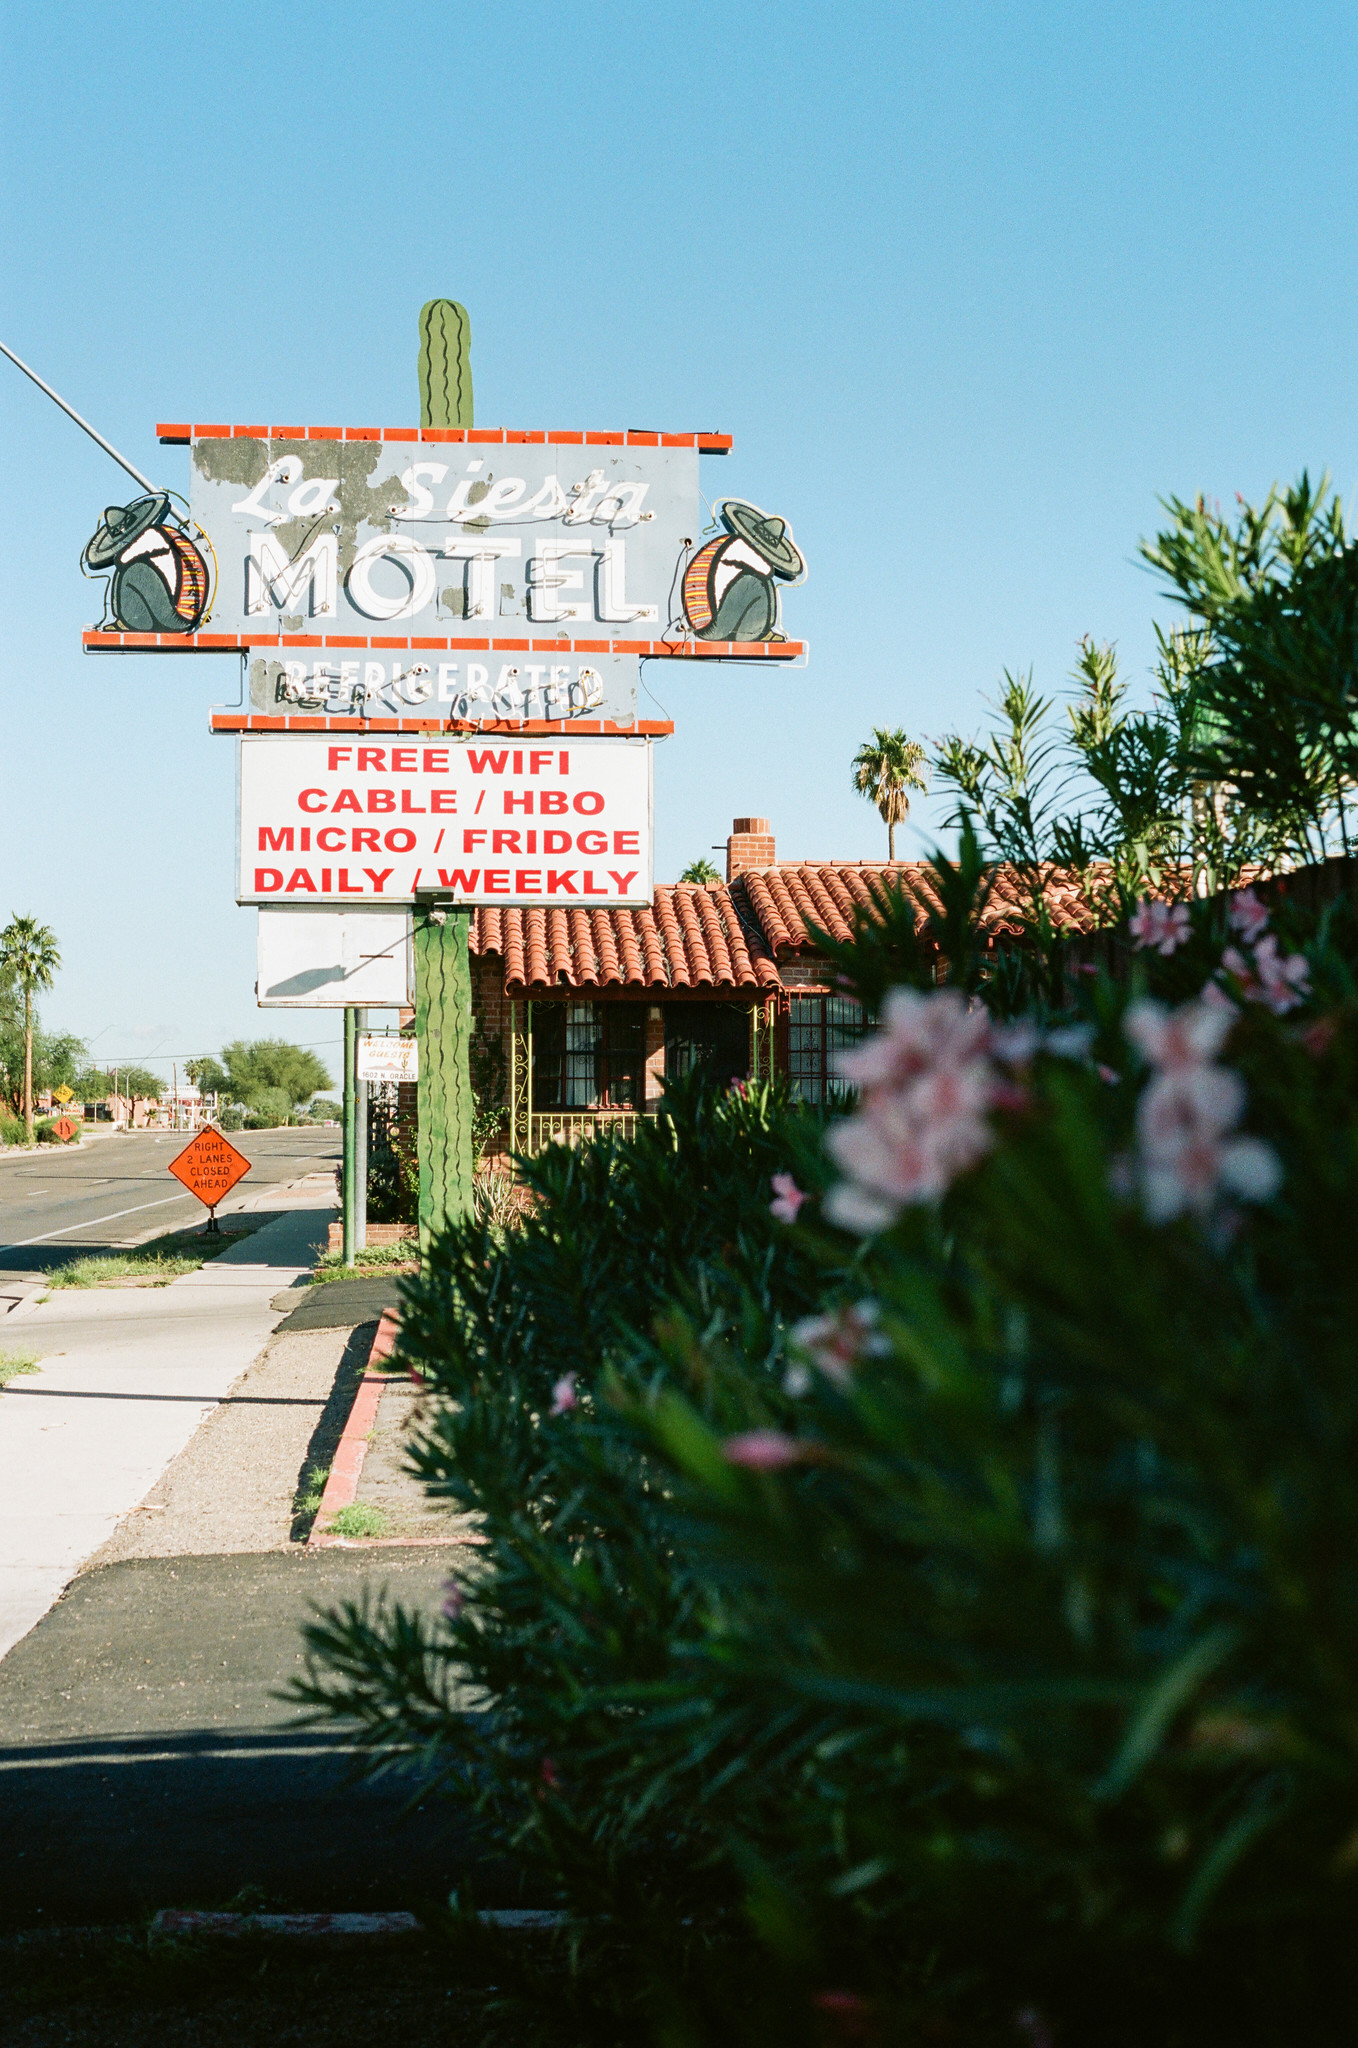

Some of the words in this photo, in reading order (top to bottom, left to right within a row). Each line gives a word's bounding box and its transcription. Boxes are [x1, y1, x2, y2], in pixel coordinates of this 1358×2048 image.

[231, 455, 342, 521] La
[387, 460, 657, 522] Siesta
[245, 532, 660, 622] MOTEL
[284, 659, 603, 703] REFRIGERATED
[328, 747, 449, 773] FREE
[467, 750, 569, 775] WIFI
[298, 789, 458, 814] CABLE
[474, 790, 486, 815] /
[504, 791, 605, 815] HBO
[258, 827, 417, 853] MICRO
[434, 829, 445, 853] /
[463, 829, 640, 855] FRIDGE
[254, 868, 394, 893] DAILY
[437, 869, 640, 895] WEEKLY
[362, 1071, 378, 1079] 1602
[187, 1155, 193, 1164] 2
[200, 1154, 233, 1164] LANES
[194, 1142, 224, 1151] RIGHT
[190, 1166, 230, 1176] CLOSED
[193, 1179, 228, 1189] AHEAD
